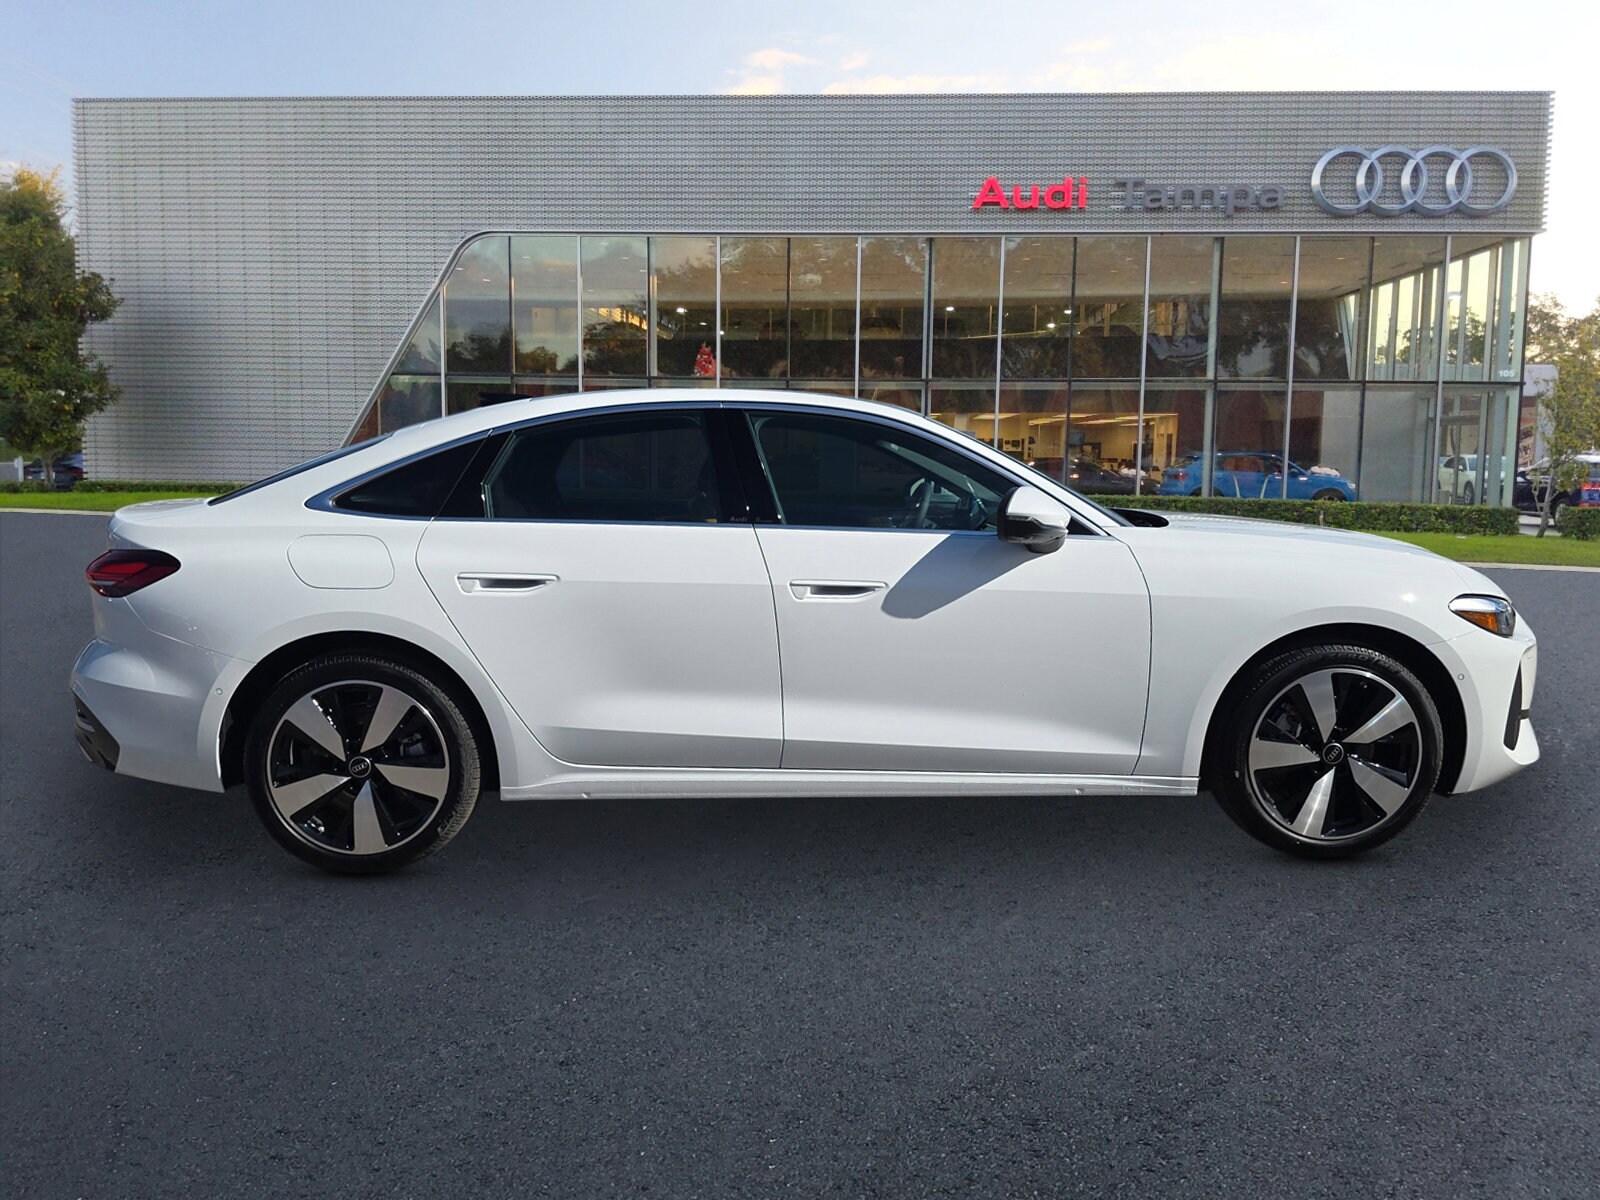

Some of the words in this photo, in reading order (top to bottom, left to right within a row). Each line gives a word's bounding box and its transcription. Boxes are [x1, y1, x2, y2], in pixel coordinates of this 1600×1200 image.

[972, 176, 1089, 210] Audi
[1114, 176, 1285, 218] Tampa
[1498, 369, 1515, 378] 105
